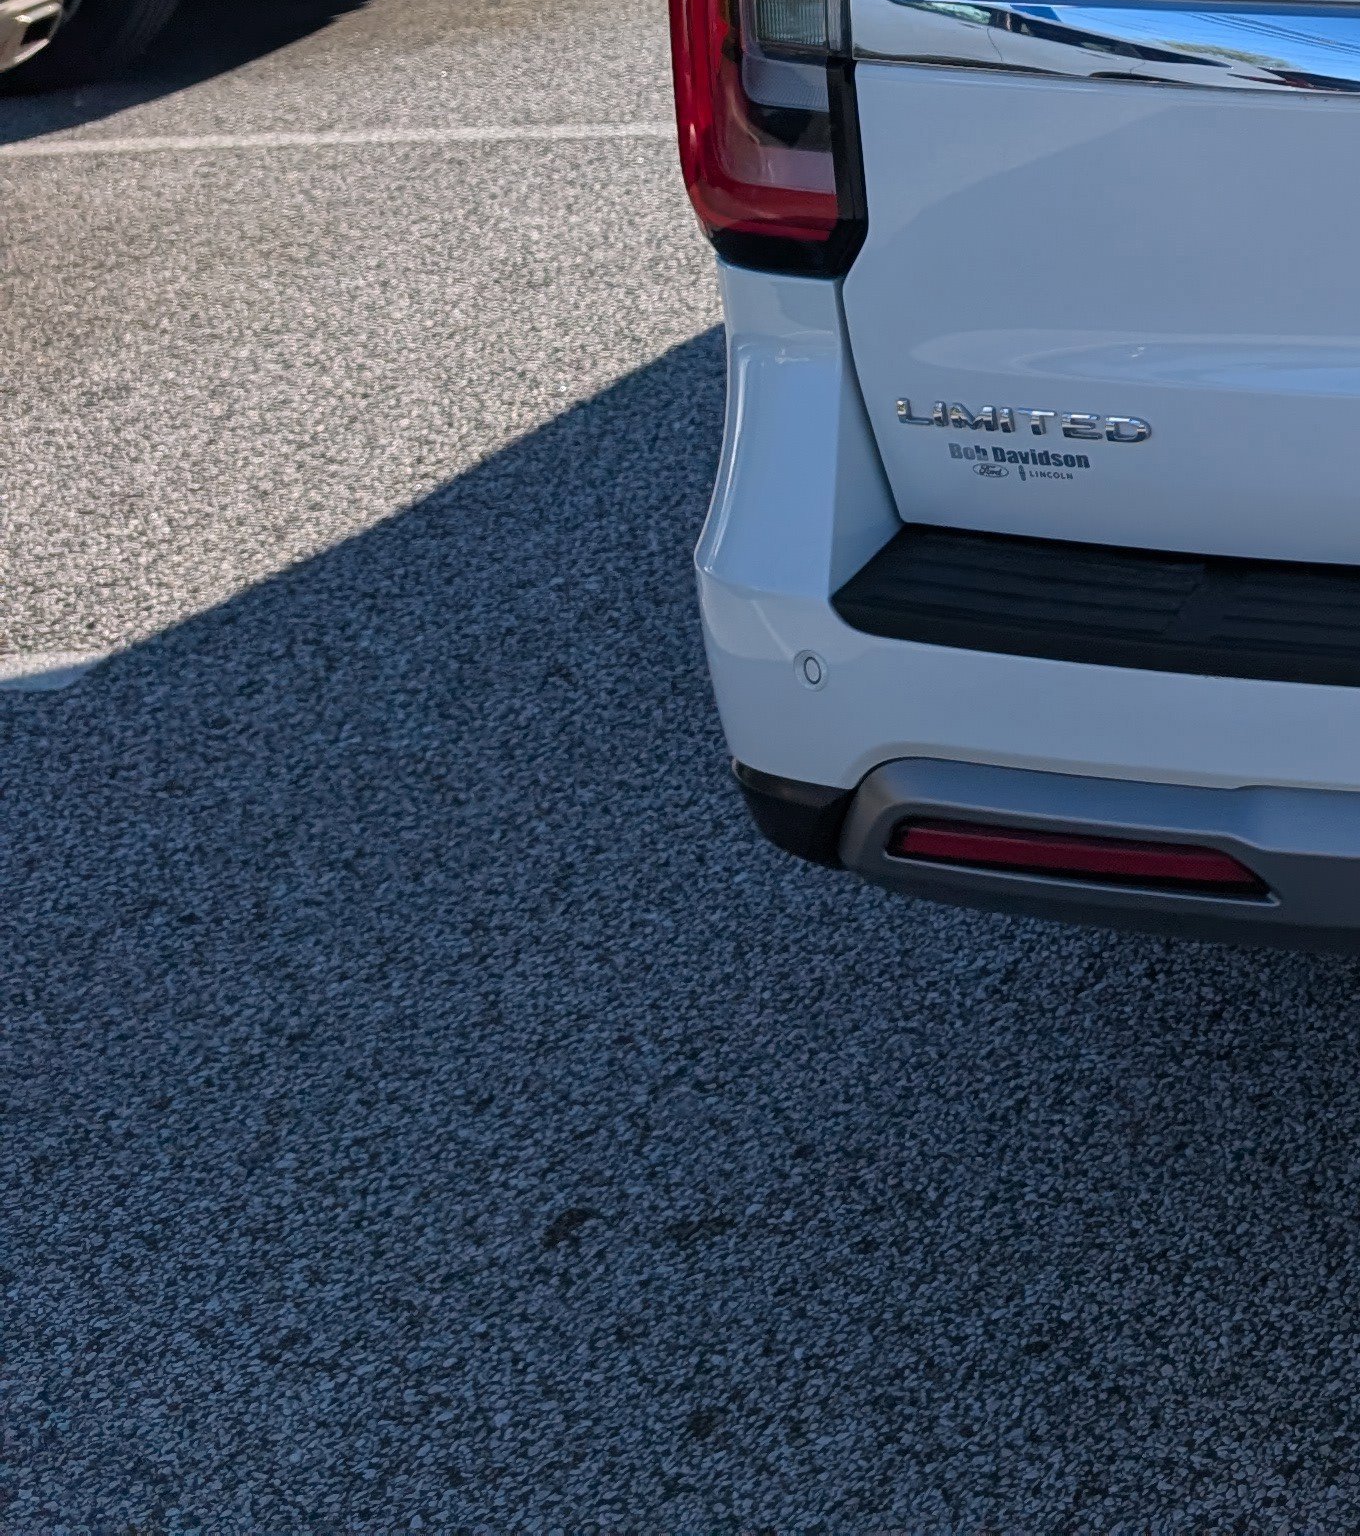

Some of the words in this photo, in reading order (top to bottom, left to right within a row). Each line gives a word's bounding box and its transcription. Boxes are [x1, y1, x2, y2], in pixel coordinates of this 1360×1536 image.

[896, 397, 1153, 443] LIMITED
[948, 443, 989, 462] Bob
[991, 446, 1091, 469] Davidson
[1029, 470, 1074, 480] LINCOLN
